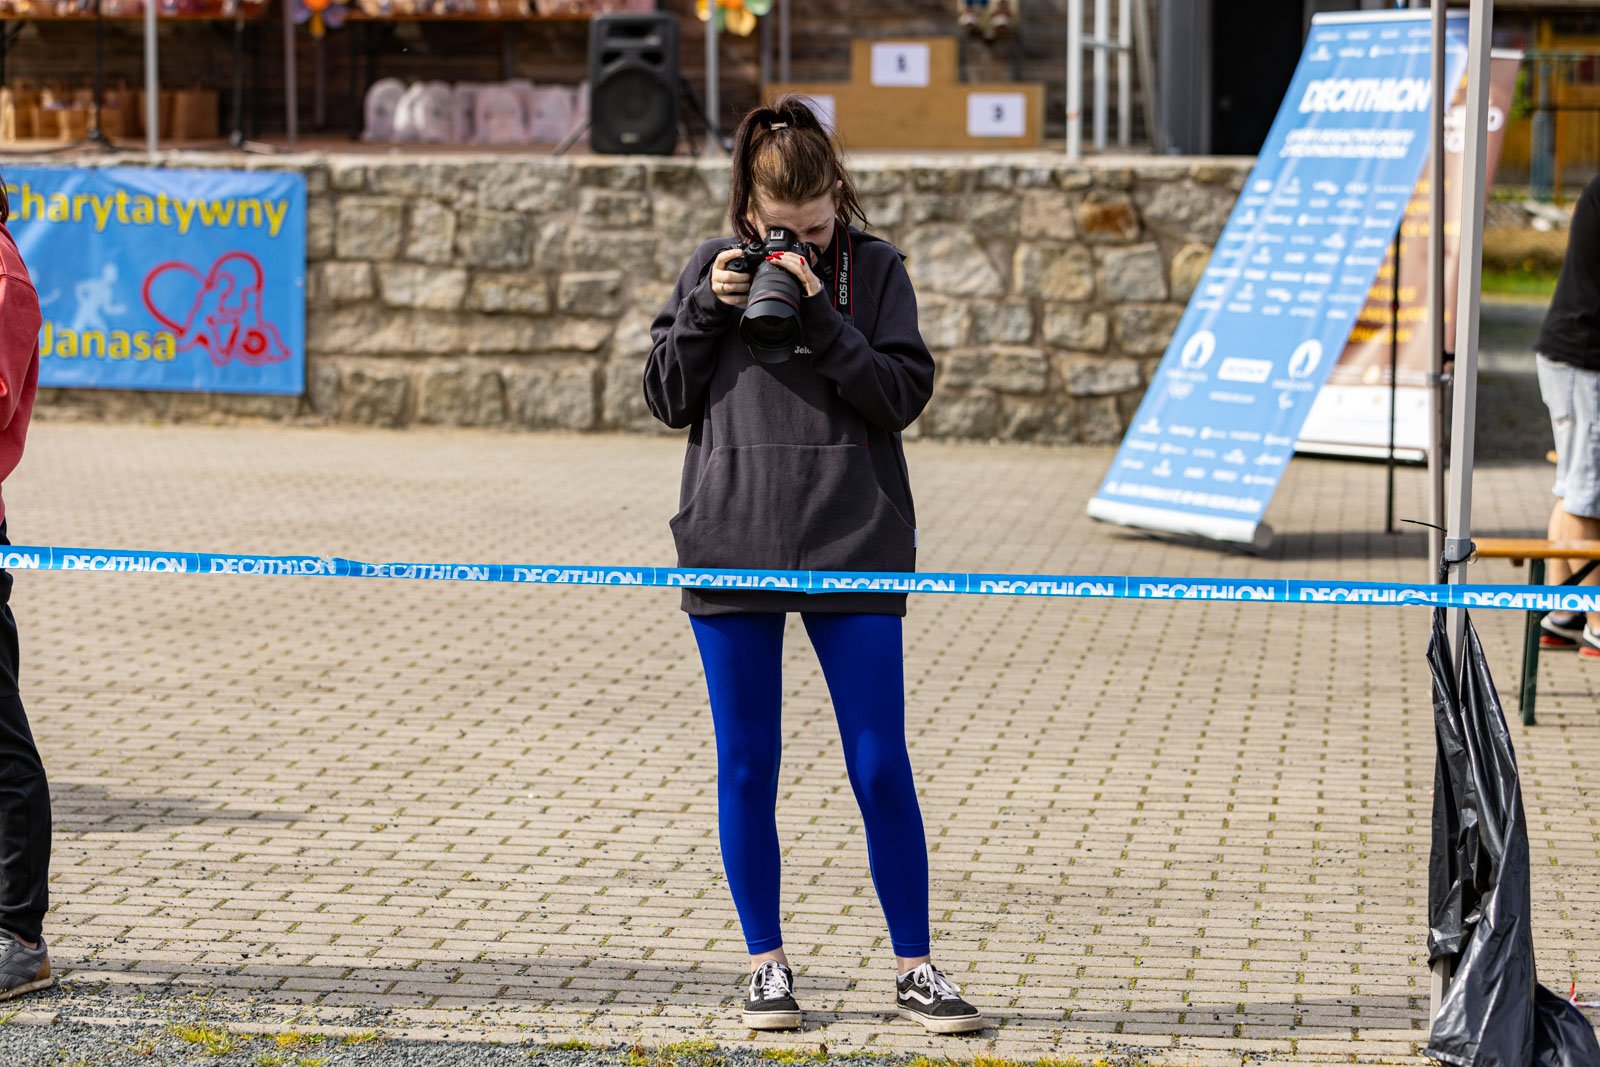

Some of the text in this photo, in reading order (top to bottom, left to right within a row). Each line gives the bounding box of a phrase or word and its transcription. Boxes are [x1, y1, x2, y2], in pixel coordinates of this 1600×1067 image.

[839, 271, 848, 284] R6
[839, 283, 848, 305] EOS
[40, 320, 176, 360] Janasa
[62, 554, 188, 572] DECATHLON
[210, 558, 337, 575] DECATHLON
[1462, 591, 1600, 612] DECATHLON
